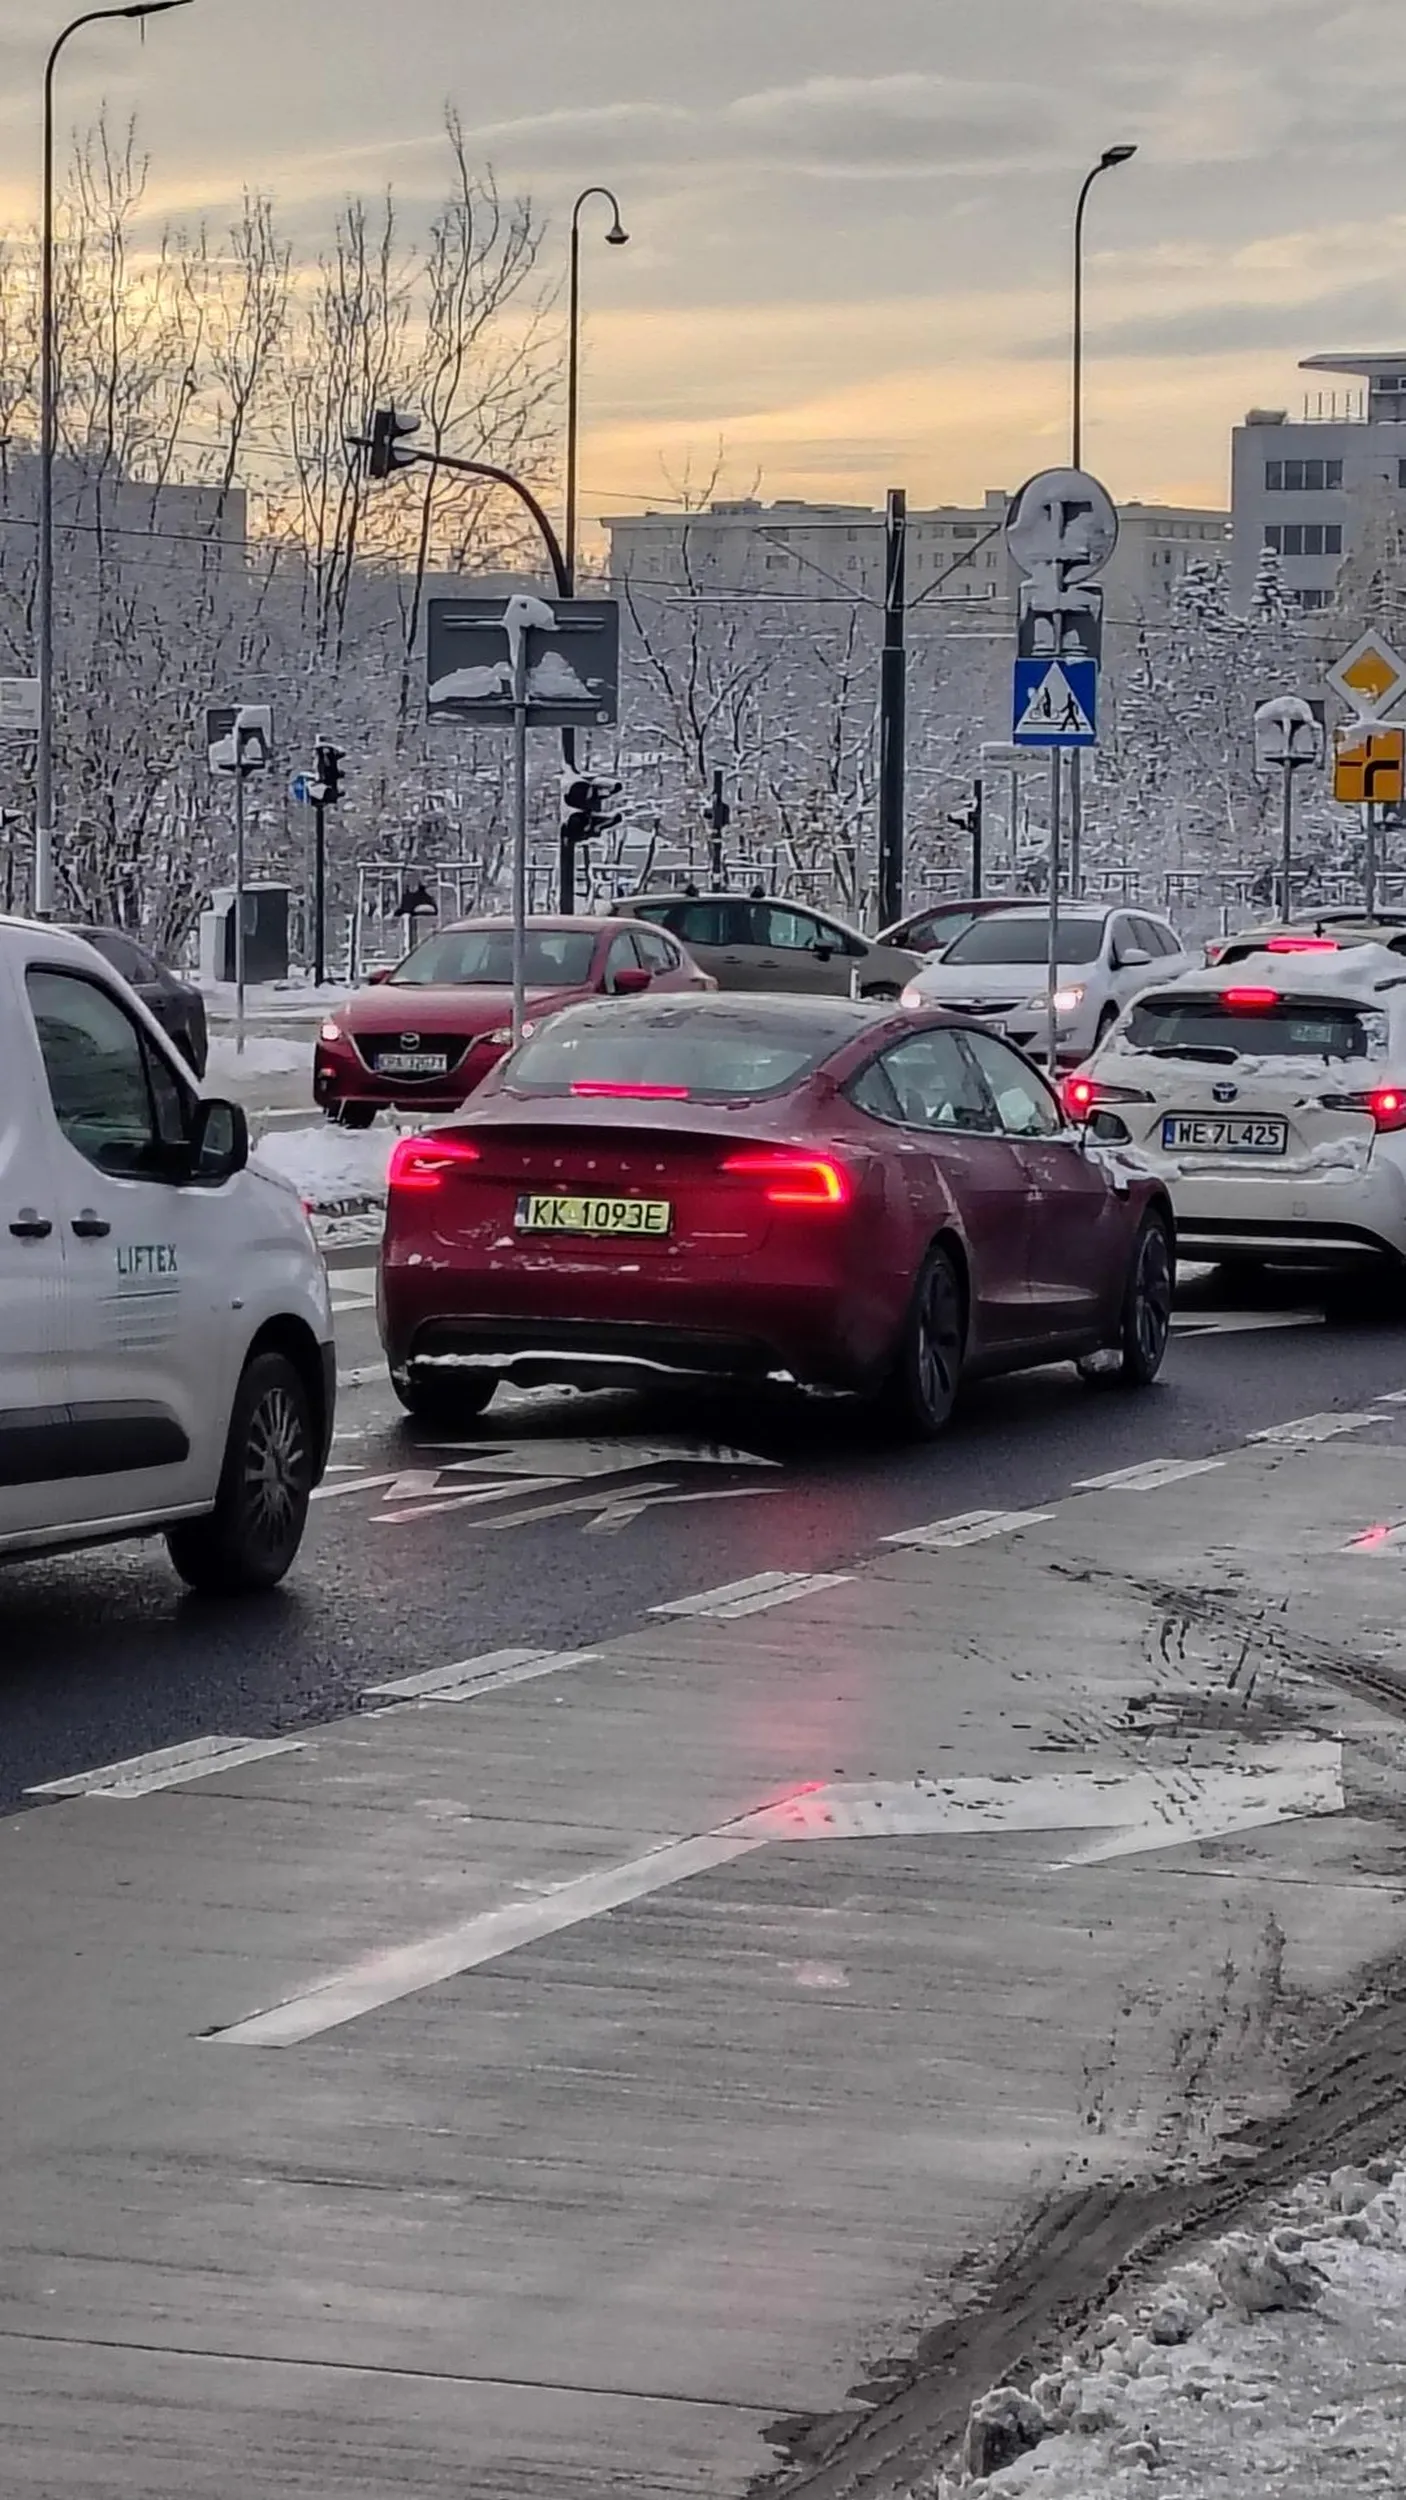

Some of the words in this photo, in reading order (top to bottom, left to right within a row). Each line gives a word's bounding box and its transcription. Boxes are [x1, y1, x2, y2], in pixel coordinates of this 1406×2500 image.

[1179, 1122, 1206, 1144] WE
[1213, 1124, 1280, 1146] 7L425
[532, 1199, 568, 1226] KK
[582, 1201, 663, 1230] 1093E
[116, 1243, 178, 1274] LIFTEX
